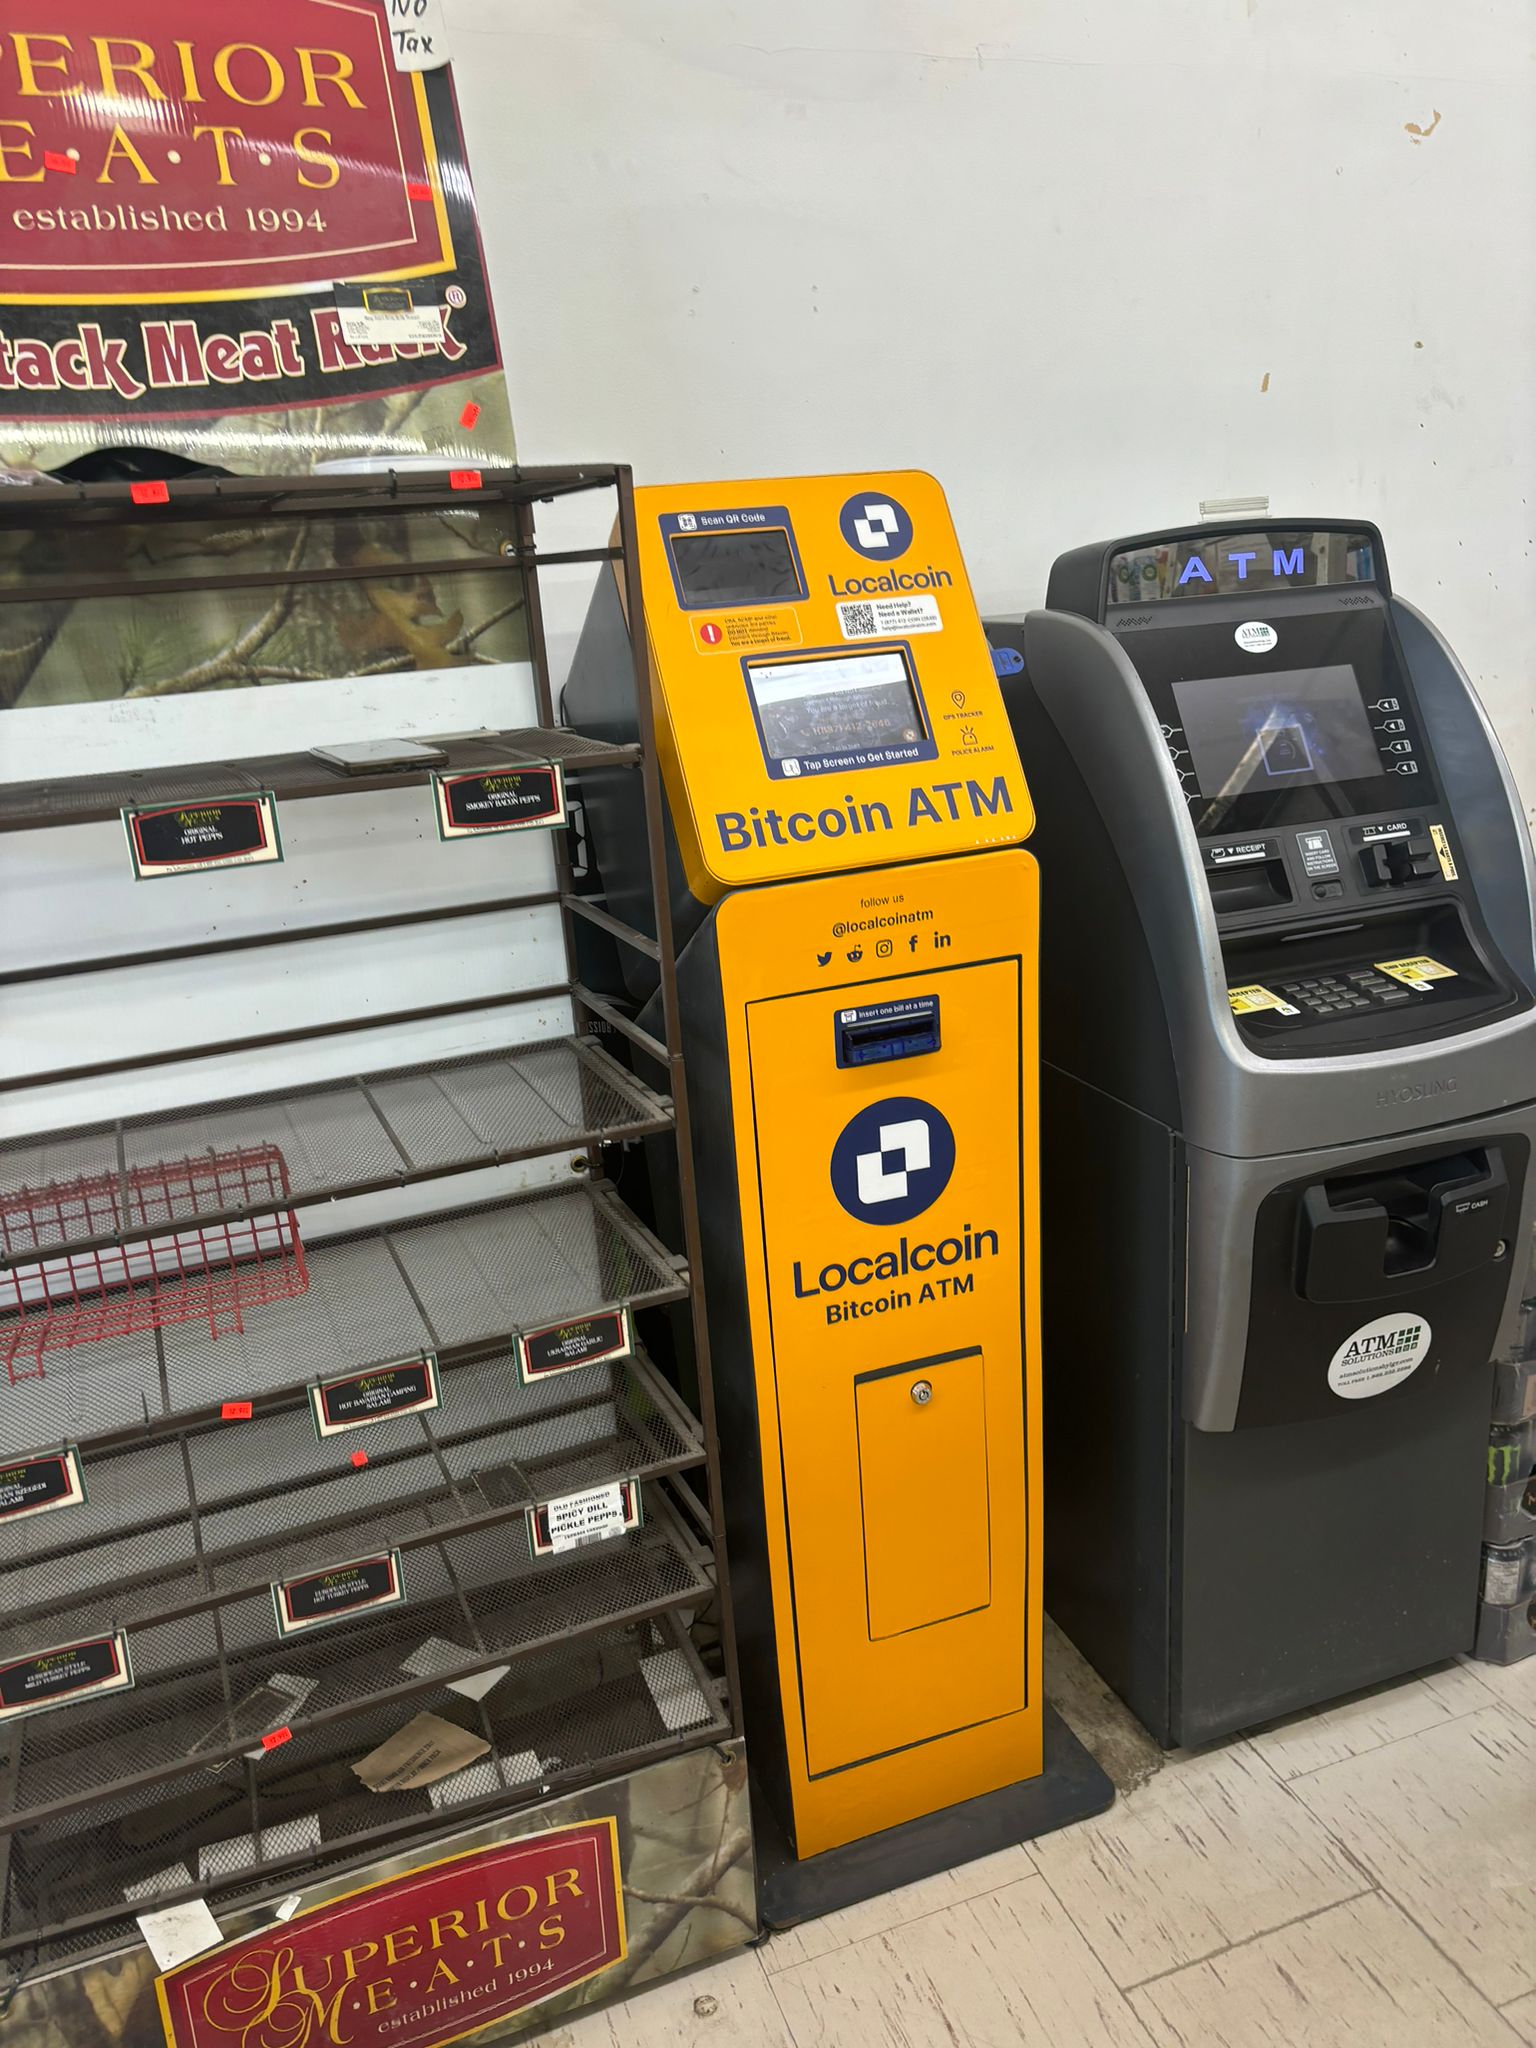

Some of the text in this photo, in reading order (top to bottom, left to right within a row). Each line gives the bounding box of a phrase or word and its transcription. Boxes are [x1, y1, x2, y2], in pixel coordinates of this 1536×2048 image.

[391, 28, 435, 55] Tax
[0, 32, 367, 110] ERIOR
[12, 204, 328, 233] established 1994
[140, 319, 305, 389] Meat
[701, 512, 766, 526] Scan QR Code
[1179, 548, 1304, 584] ATM
[828, 564, 952, 597] Localcoin
[876, 602, 893, 610] Need
[878, 610, 895, 618] Need
[803, 747, 919, 771] Tap Screen to Get Started
[951, 745, 995, 757] POLICE ALARM
[466, 793, 541, 811] SMOKEY BACON PEPPS
[487, 791, 517, 801] ORIGINAL
[715, 775, 1013, 852] Bitcoin ATM
[181, 831, 223, 845] HOT PEPPS
[183, 826, 218, 838] ORIGINAL
[1386, 822, 1407, 832] CARD
[1236, 843, 1266, 854] RECEIPT
[860, 894, 905, 909] follow us
[832, 908, 934, 937] @localcoinatm
[859, 1009, 879, 1019] Insert
[880, 1007, 893, 1015] one
[894, 1004, 905, 1013] bill
[905, 1003, 912, 1011] at
[1471, 1199, 1488, 1210] CASH
[793, 1223, 999, 1299] Localcoin
[826, 1273, 974, 1325] Bitcoin ATM
[1344, 1331, 1398, 1359] ATM
[1341, 1348, 1395, 1367] SOLUTIONS
[338, 1400, 353, 1411] HOT
[551, 1516, 586, 1535] PICKLE
[587, 1510, 618, 1526] PEPPS
[555, 1500, 608, 1523] SPICY DILL
[204, 1866, 585, 2032] SUPERIOR
[378, 1957, 556, 2034] established 1994
